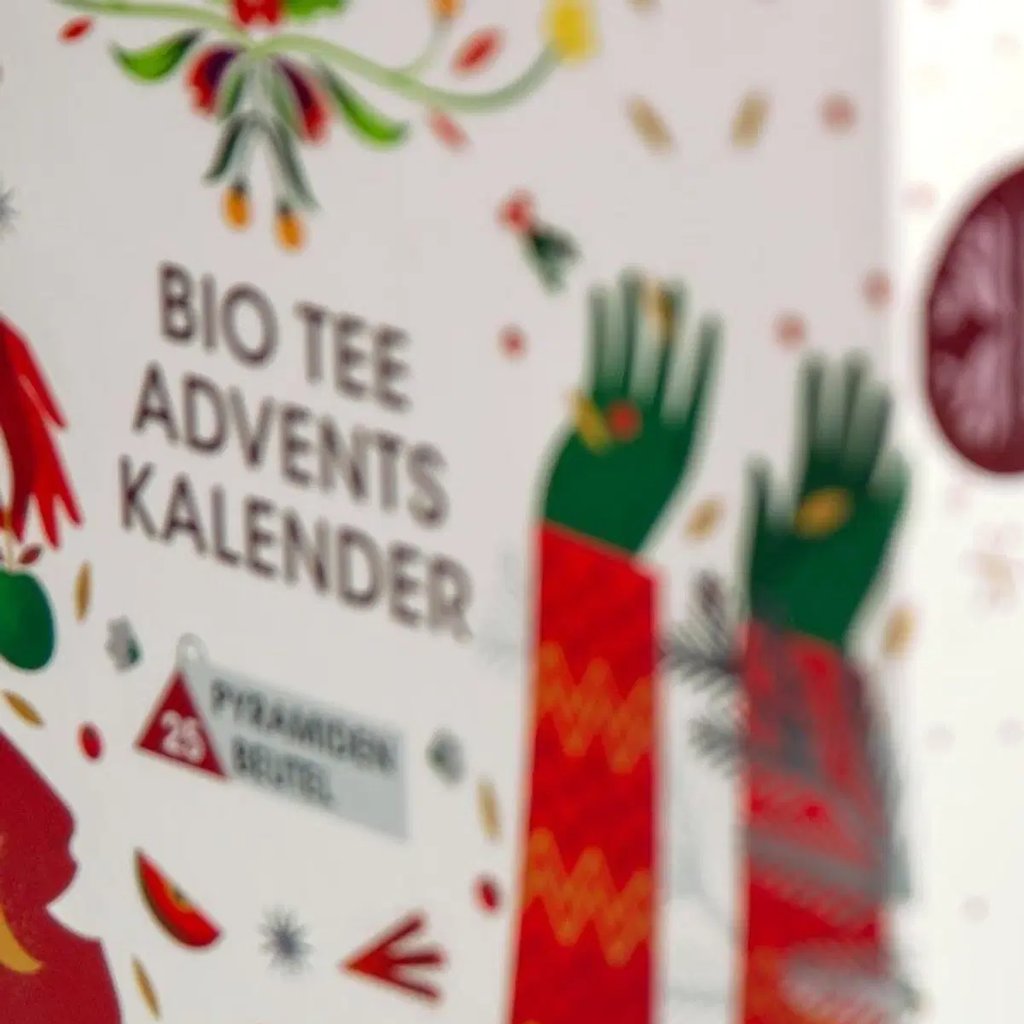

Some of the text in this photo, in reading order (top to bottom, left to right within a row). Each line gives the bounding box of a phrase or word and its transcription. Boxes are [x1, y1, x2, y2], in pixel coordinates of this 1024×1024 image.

[158, 260, 412, 412] BIO TEE
[132, 361, 450, 528] ADVENTS
[118, 454, 474, 642] KALENDER
